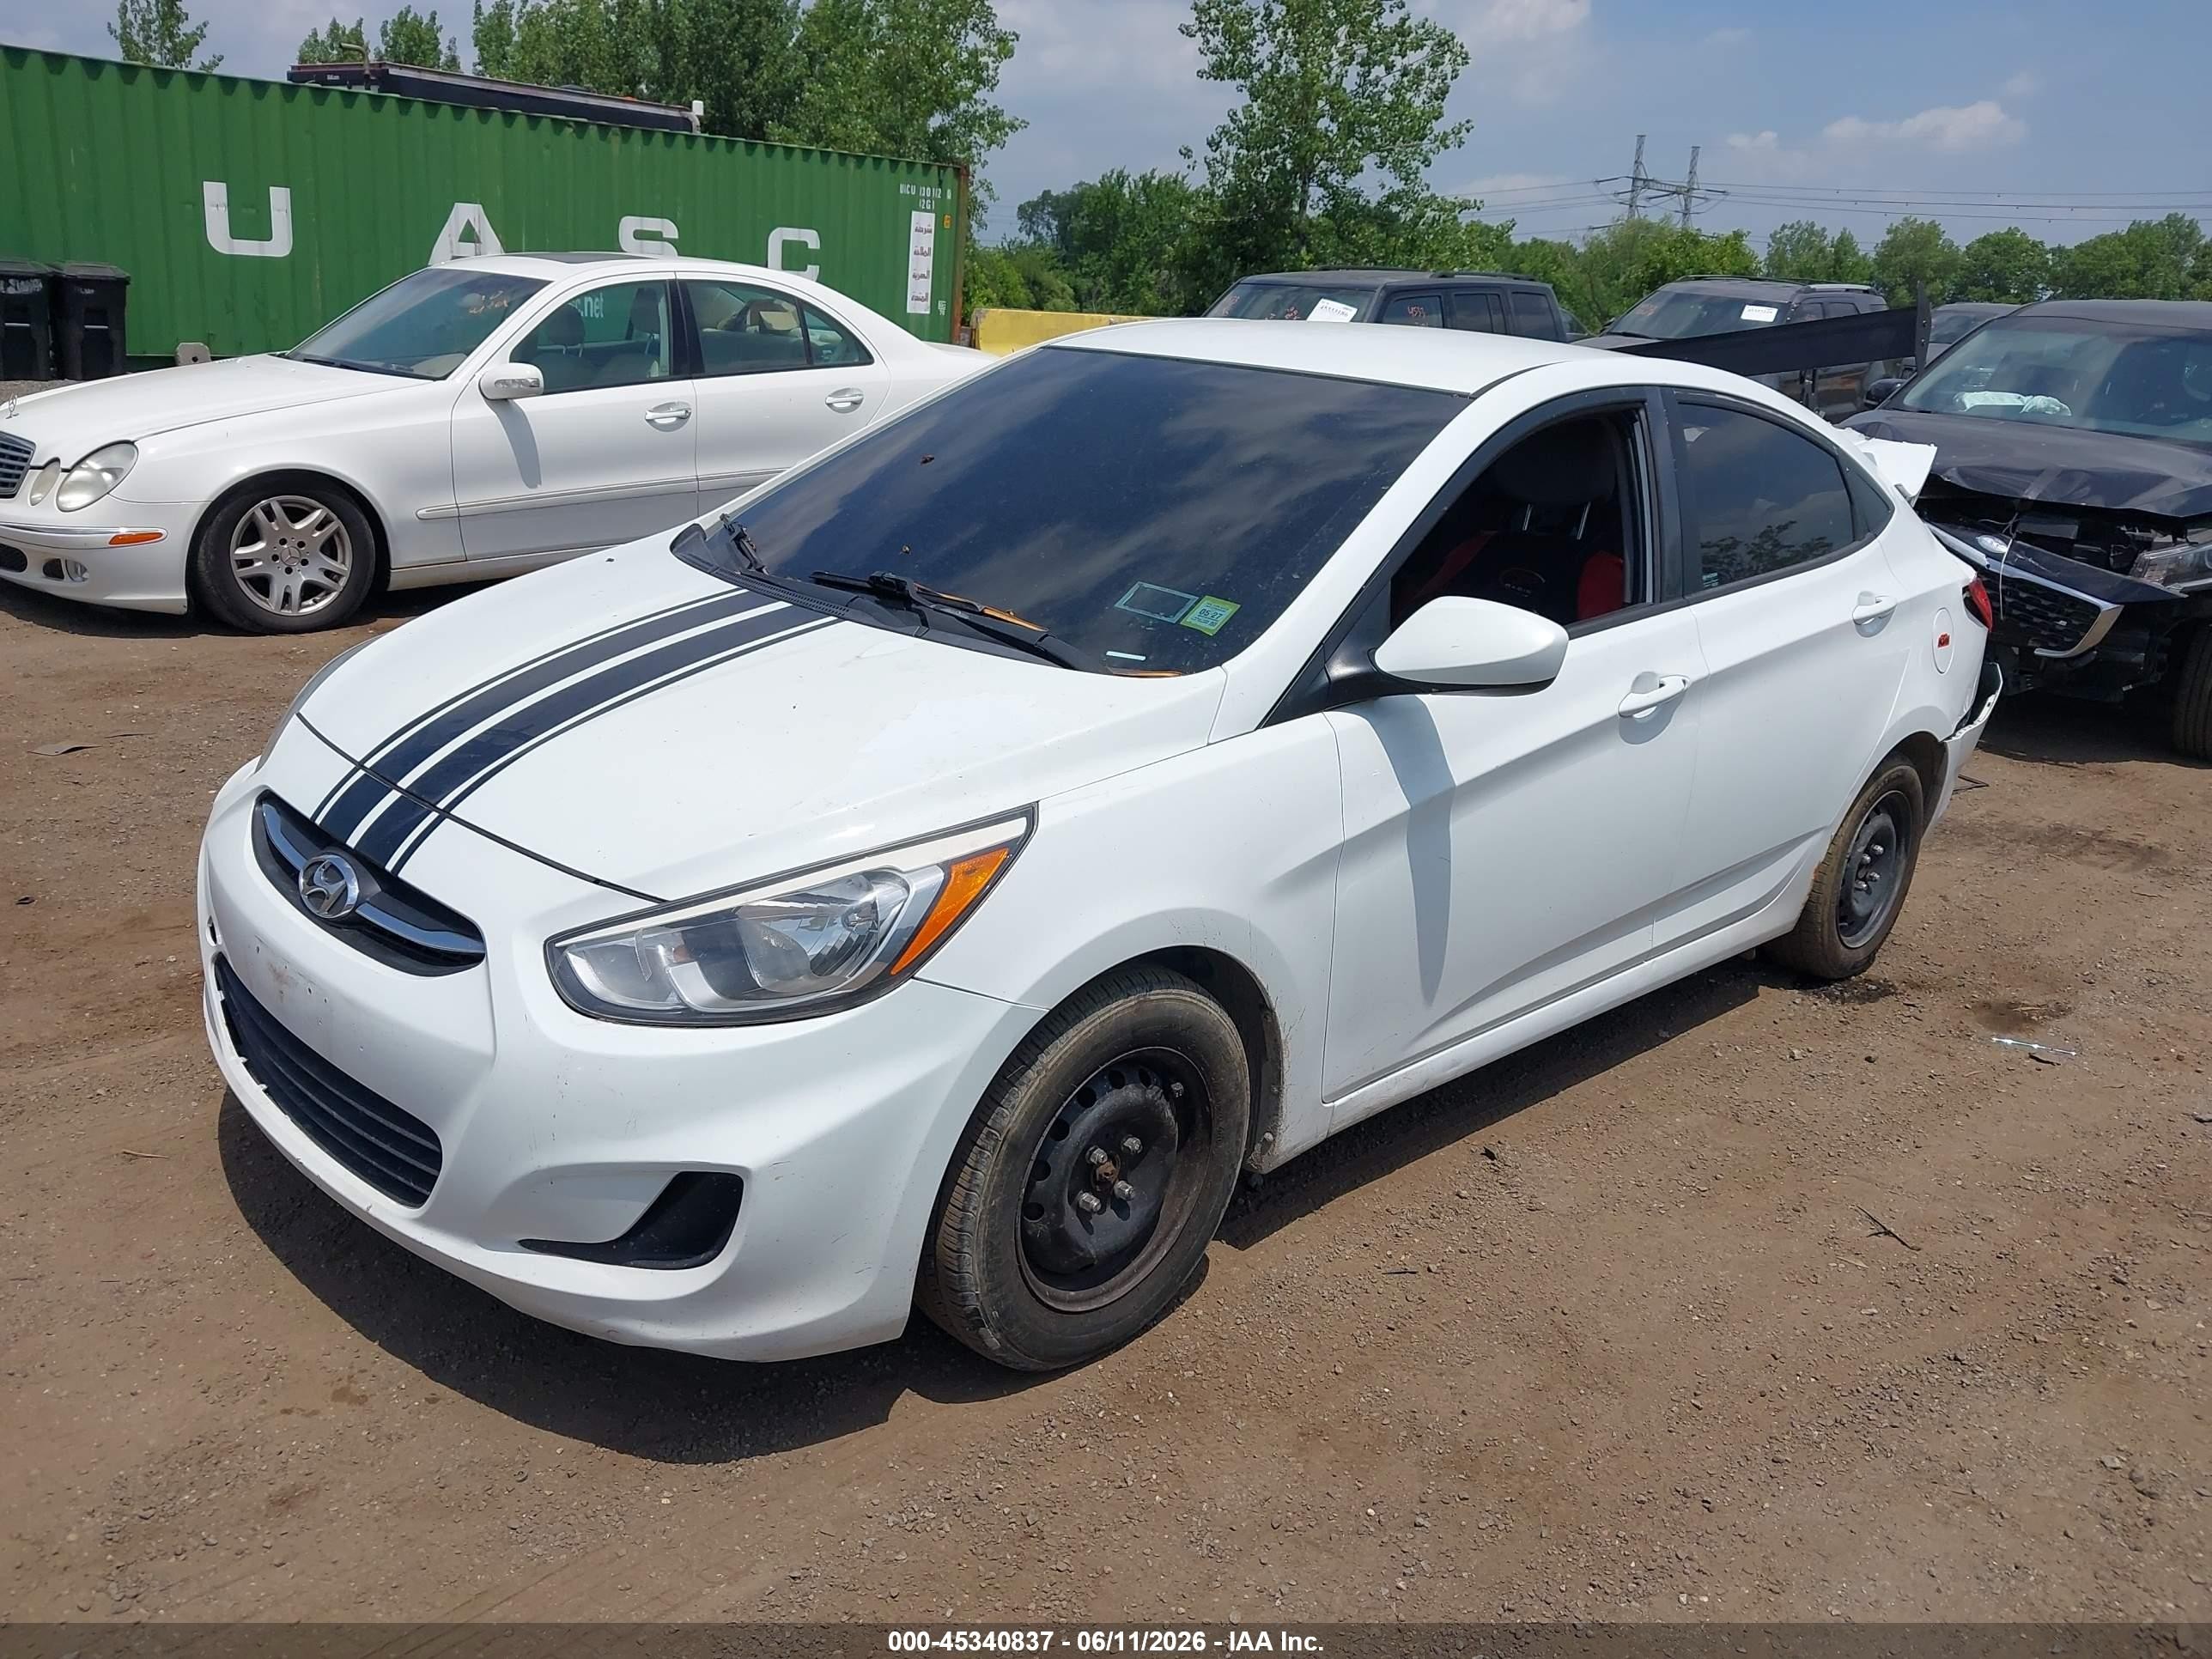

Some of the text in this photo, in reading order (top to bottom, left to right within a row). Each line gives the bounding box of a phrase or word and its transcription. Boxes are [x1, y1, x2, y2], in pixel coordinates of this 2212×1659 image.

[203, 181, 820, 283] U A S C
